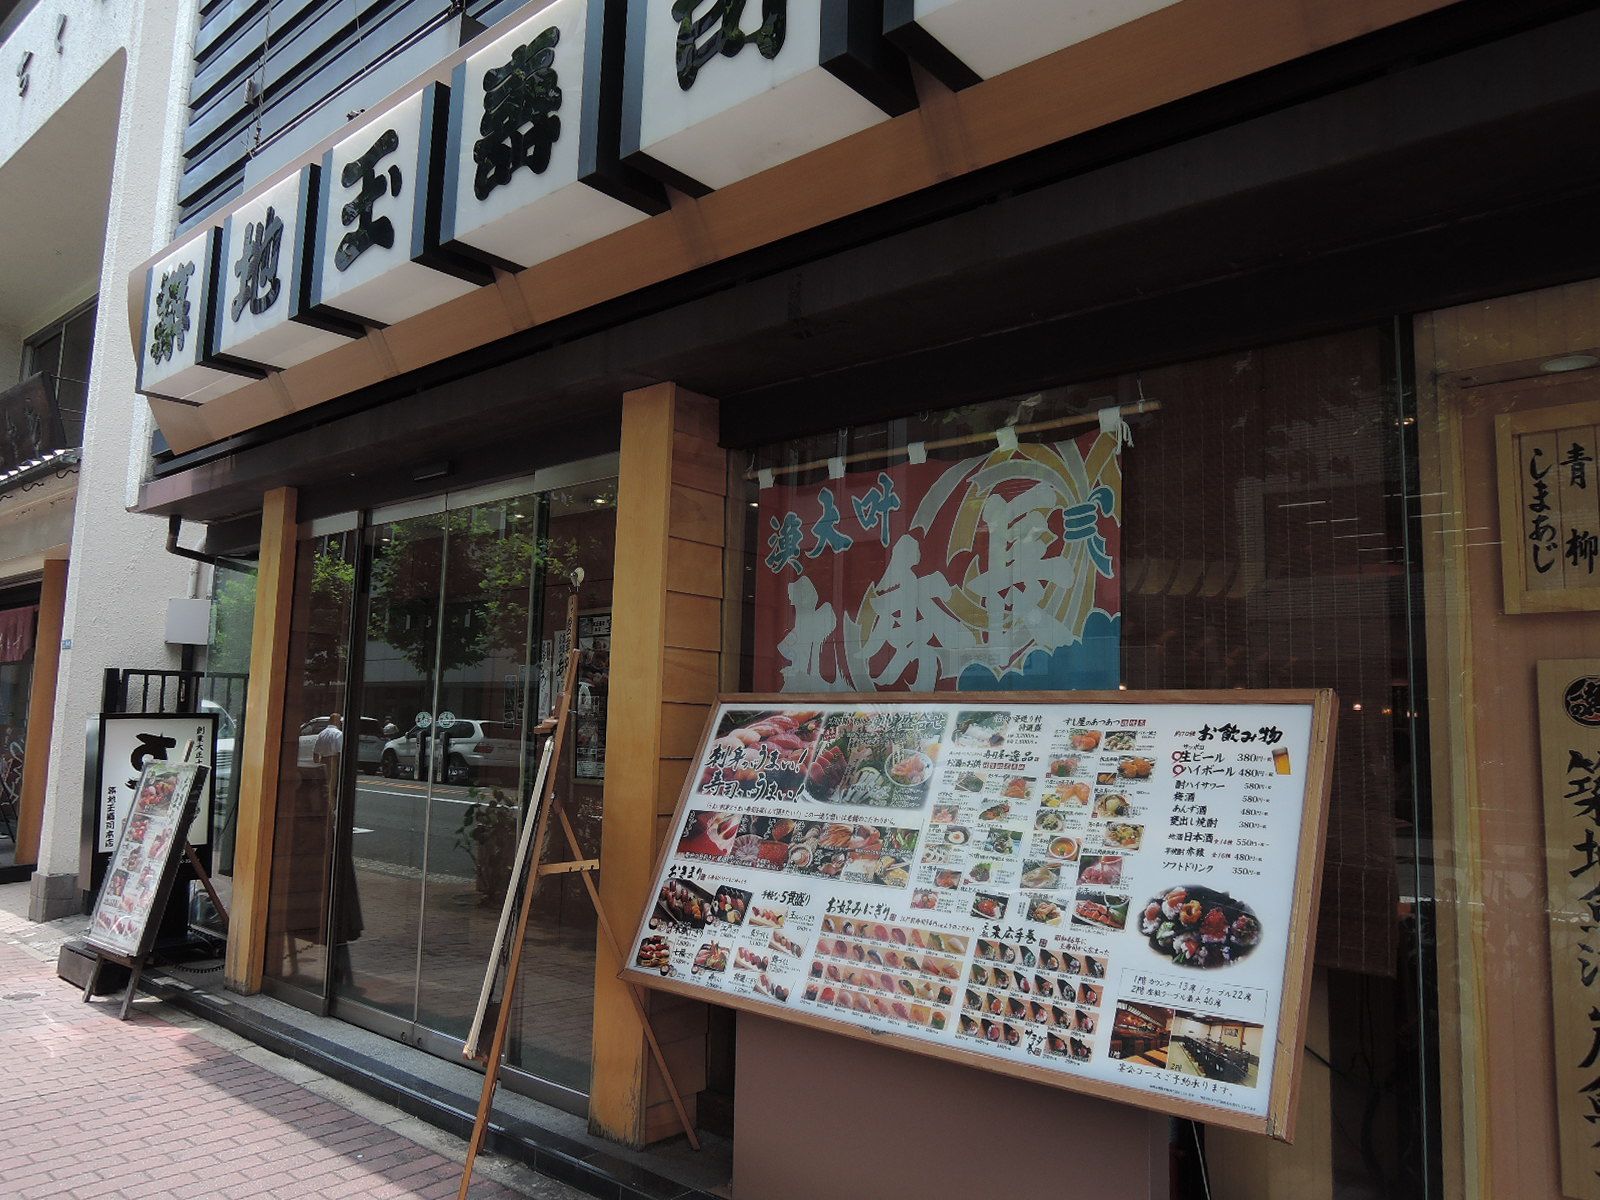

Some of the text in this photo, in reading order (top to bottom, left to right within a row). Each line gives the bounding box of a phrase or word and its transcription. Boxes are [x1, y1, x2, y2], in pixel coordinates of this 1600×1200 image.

[1528, 448, 1558, 574] しまあじ
[1560, 442, 1599, 575] 青柳
[1198, 723, 1284, 745] お飲み物
[1179, 750, 1225, 763] 生ビール
[1182, 765, 1236, 777] ハイボール
[1174, 780, 1226, 790] 酎ハイサワー
[1172, 804, 1208, 816] あんず酒
[1161, 861, 1214, 873] ソフトドリンク
[825, 896, 891, 922] お好みにぎり
